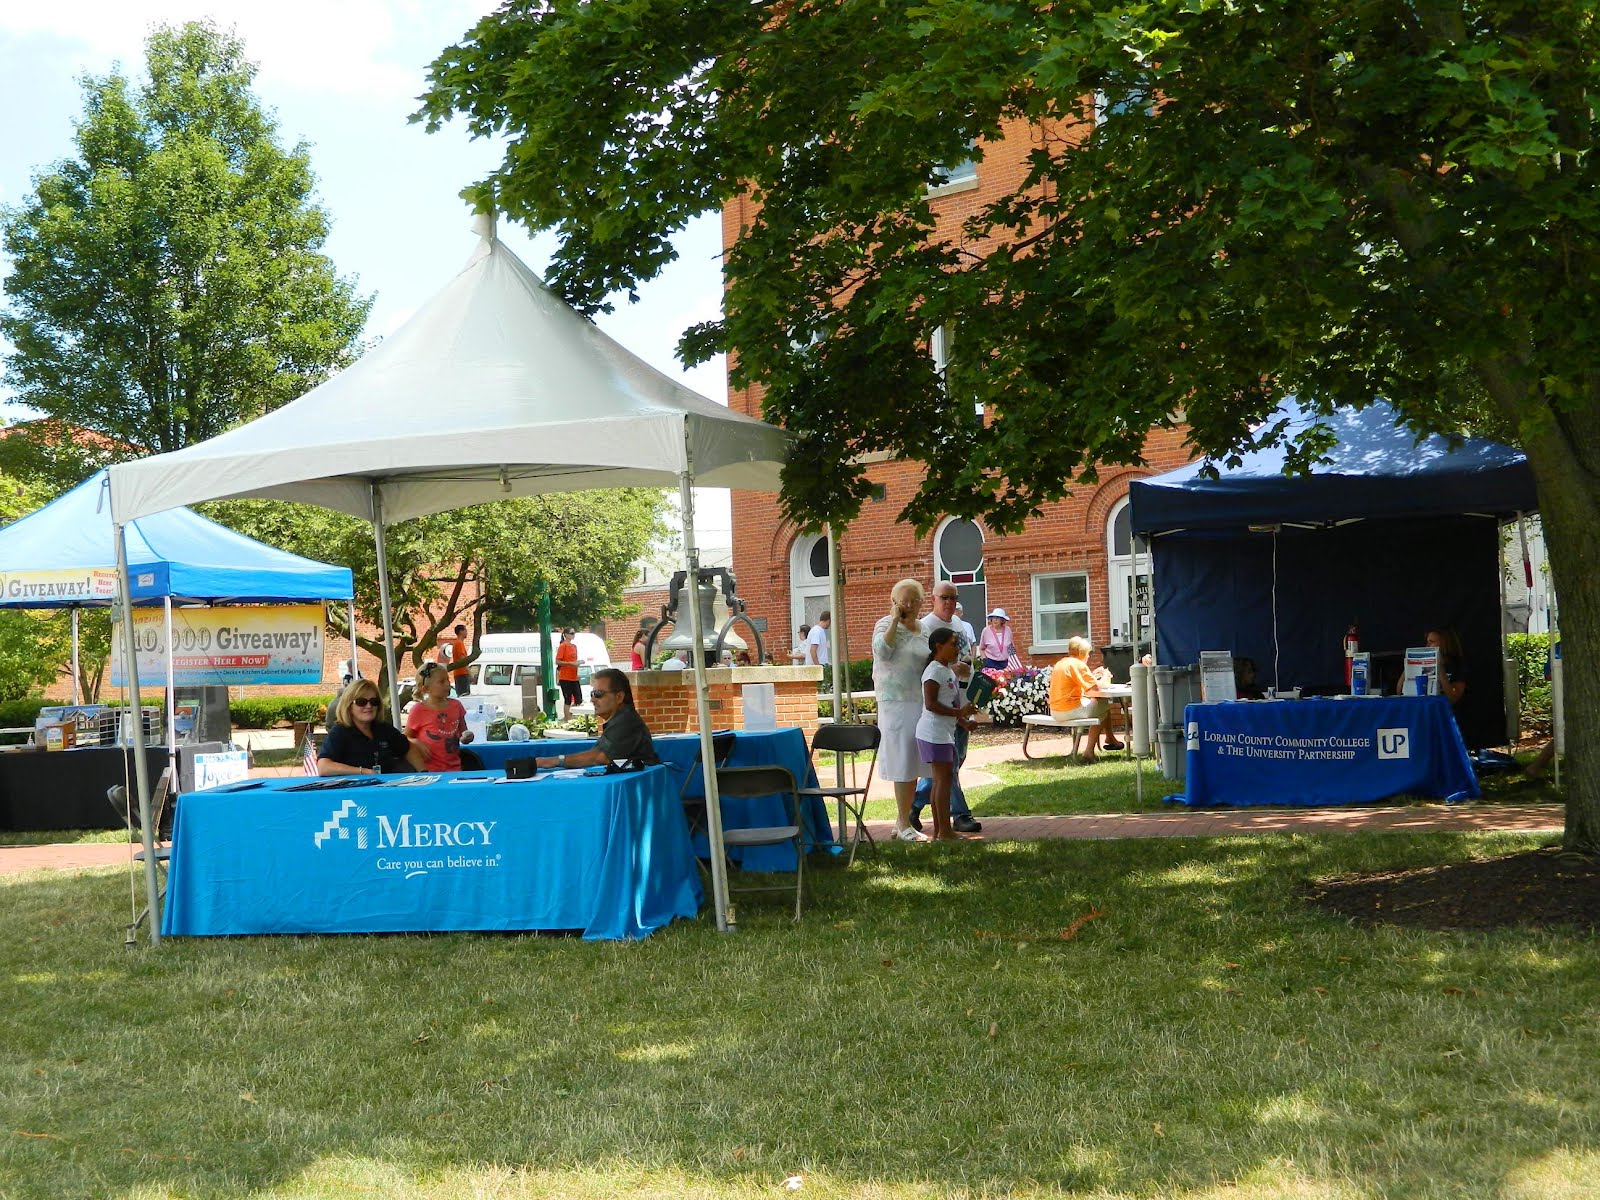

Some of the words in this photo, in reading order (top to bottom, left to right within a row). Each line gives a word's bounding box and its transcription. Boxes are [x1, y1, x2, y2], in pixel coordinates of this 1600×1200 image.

[8, 577, 91, 598] GIVEAWAY!
[216, 625, 318, 655] Giveaway!
[171, 656, 209, 667] EGISTER
[213, 656, 237, 666] HERE
[240, 655, 266, 666] NOW!
[1204, 730, 1236, 743] LORAIN
[1237, 733, 1273, 746] COUNTY
[1275, 735, 1328, 748] COMMUNITY
[1329, 736, 1370, 747] COLLEGE
[1217, 745, 1225, 755] &
[1226, 745, 1244, 756] THE
[1246, 746, 1297, 759] UNIVERSITY
[1298, 748, 1356, 760] PARTNERSHIP
[376, 814, 497, 849] MERCY
[377, 858, 401, 870] Care
[404, 860, 424, 872] you
[426, 858, 444, 868] can
[447, 855, 483, 868] believe
